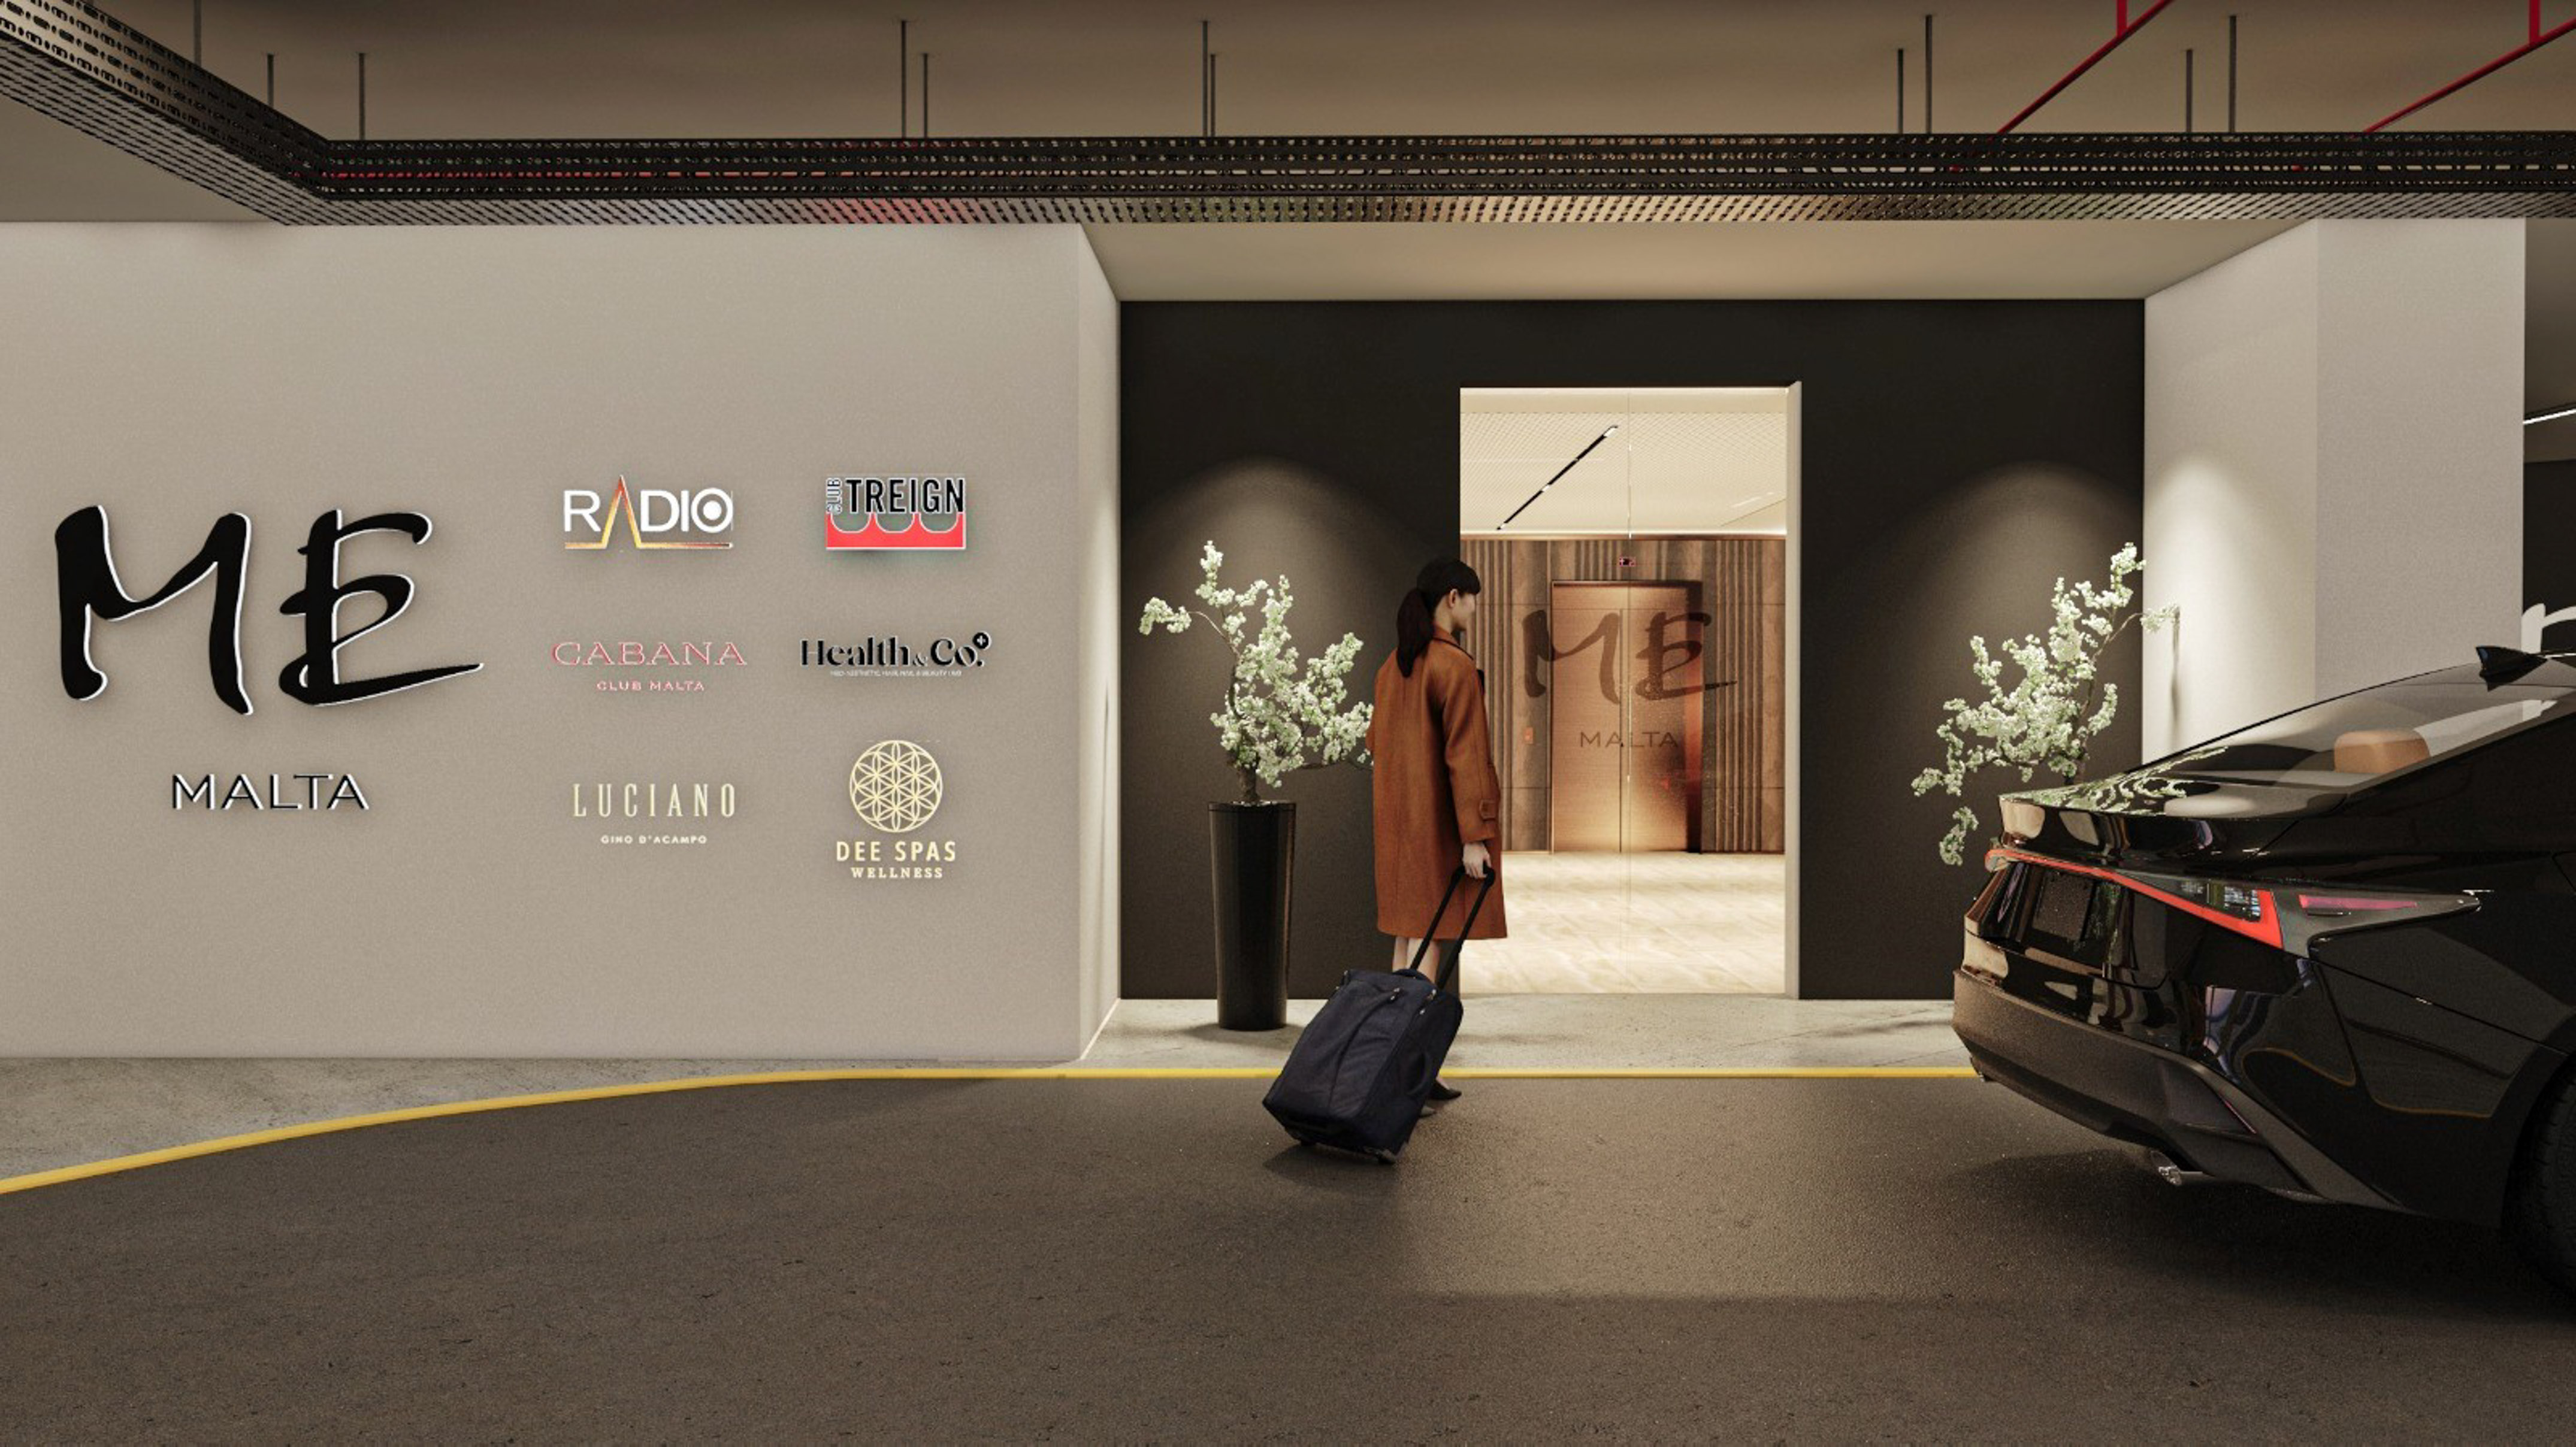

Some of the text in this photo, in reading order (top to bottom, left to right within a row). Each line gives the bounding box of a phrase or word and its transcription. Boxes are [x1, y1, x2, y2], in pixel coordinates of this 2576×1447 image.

[845, 478, 966, 514] TREIGN
[563, 475, 733, 549] RADIO
[55, 505, 484, 715] ME
[552, 641, 748, 666] CABANA
[800, 636, 911, 667] Health
[1522, 610, 1737, 705] ME
[597, 681, 705, 691] CLUB MALTA
[1580, 731, 1677, 748] MALTA
[172, 773, 370, 810] MALTA
[573, 783, 735, 818] LUCIANO
[600, 835, 708, 844] GINO D'ACAMPO
[836, 840, 956, 862] DEE SPAS
[851, 867, 943, 879] WELLNESS
